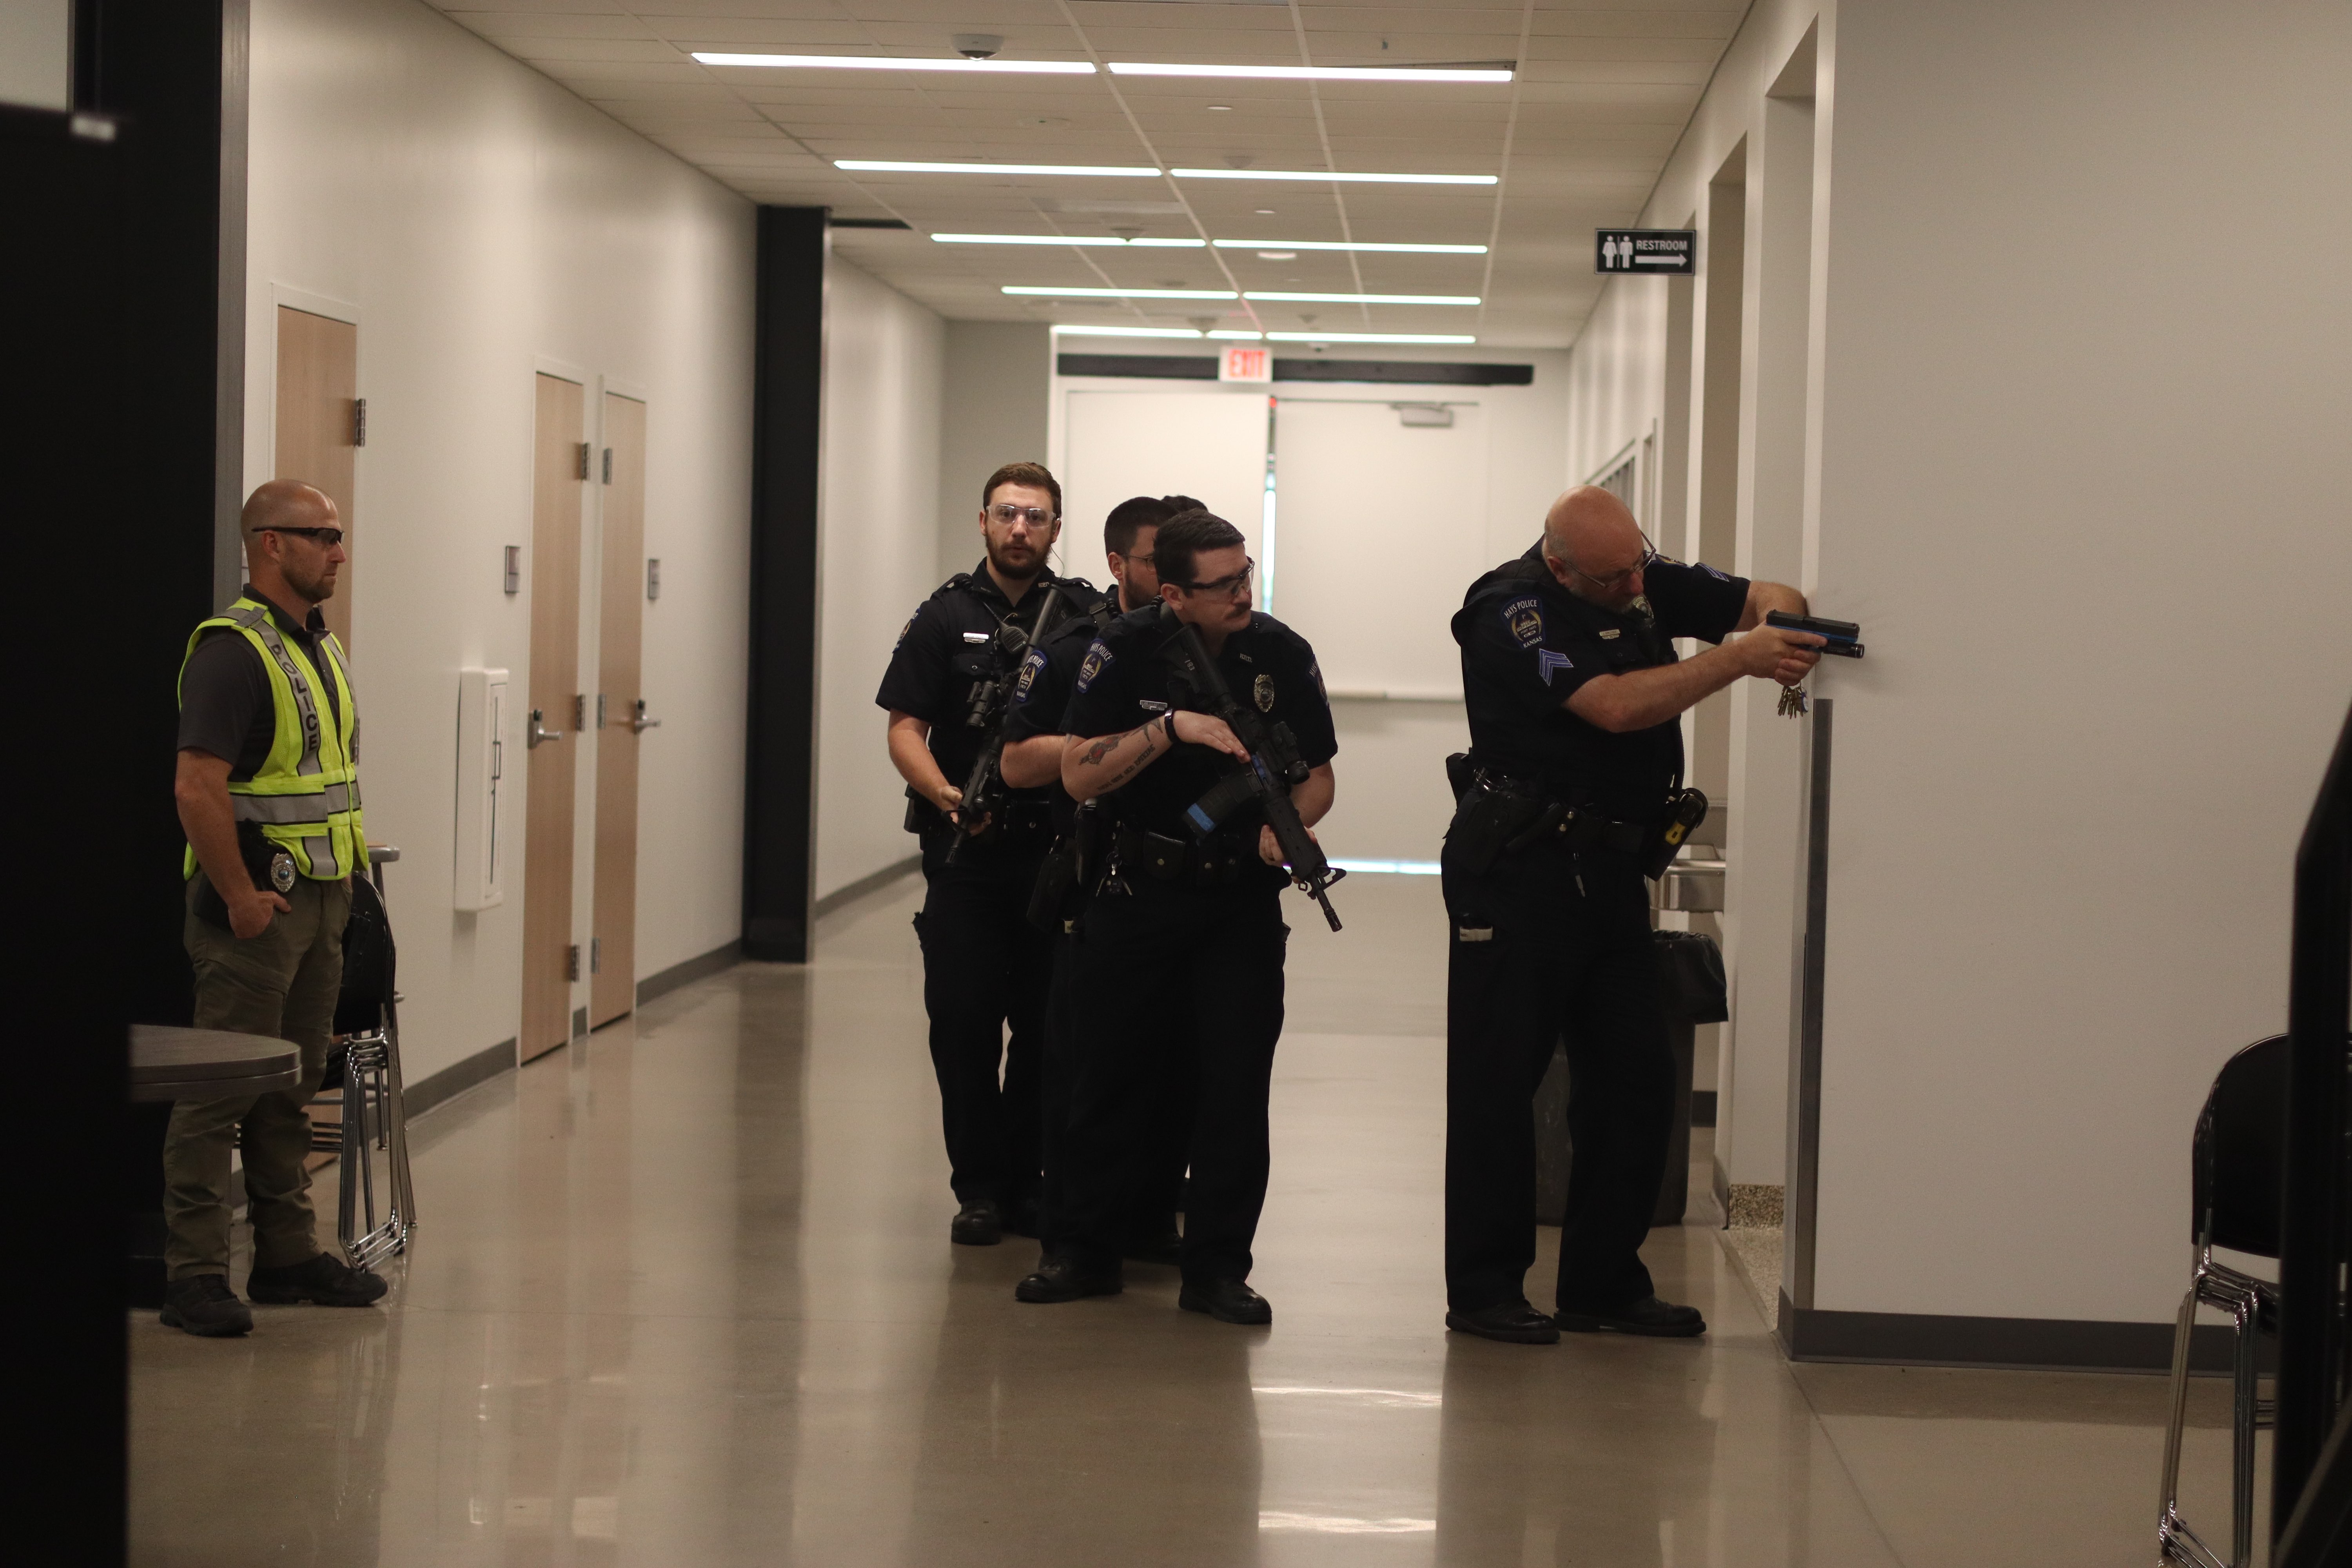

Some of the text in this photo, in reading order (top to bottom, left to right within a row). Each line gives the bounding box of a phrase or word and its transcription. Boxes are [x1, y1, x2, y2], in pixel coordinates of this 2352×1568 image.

[1636, 240, 1687, 250] RESTROOM
[1229, 349, 1266, 377] EXIT
[1504, 600, 1537, 619] HAYS POLICE
[1523, 636, 1543, 648] KANSAS
[1097, 645, 1112, 661] POLICE
[1032, 655, 1044, 668] POLICE
[1185, 660, 1195, 670] 183
[1078, 680, 1087, 690] KANSAS
[270, 644, 318, 751] POLICE
